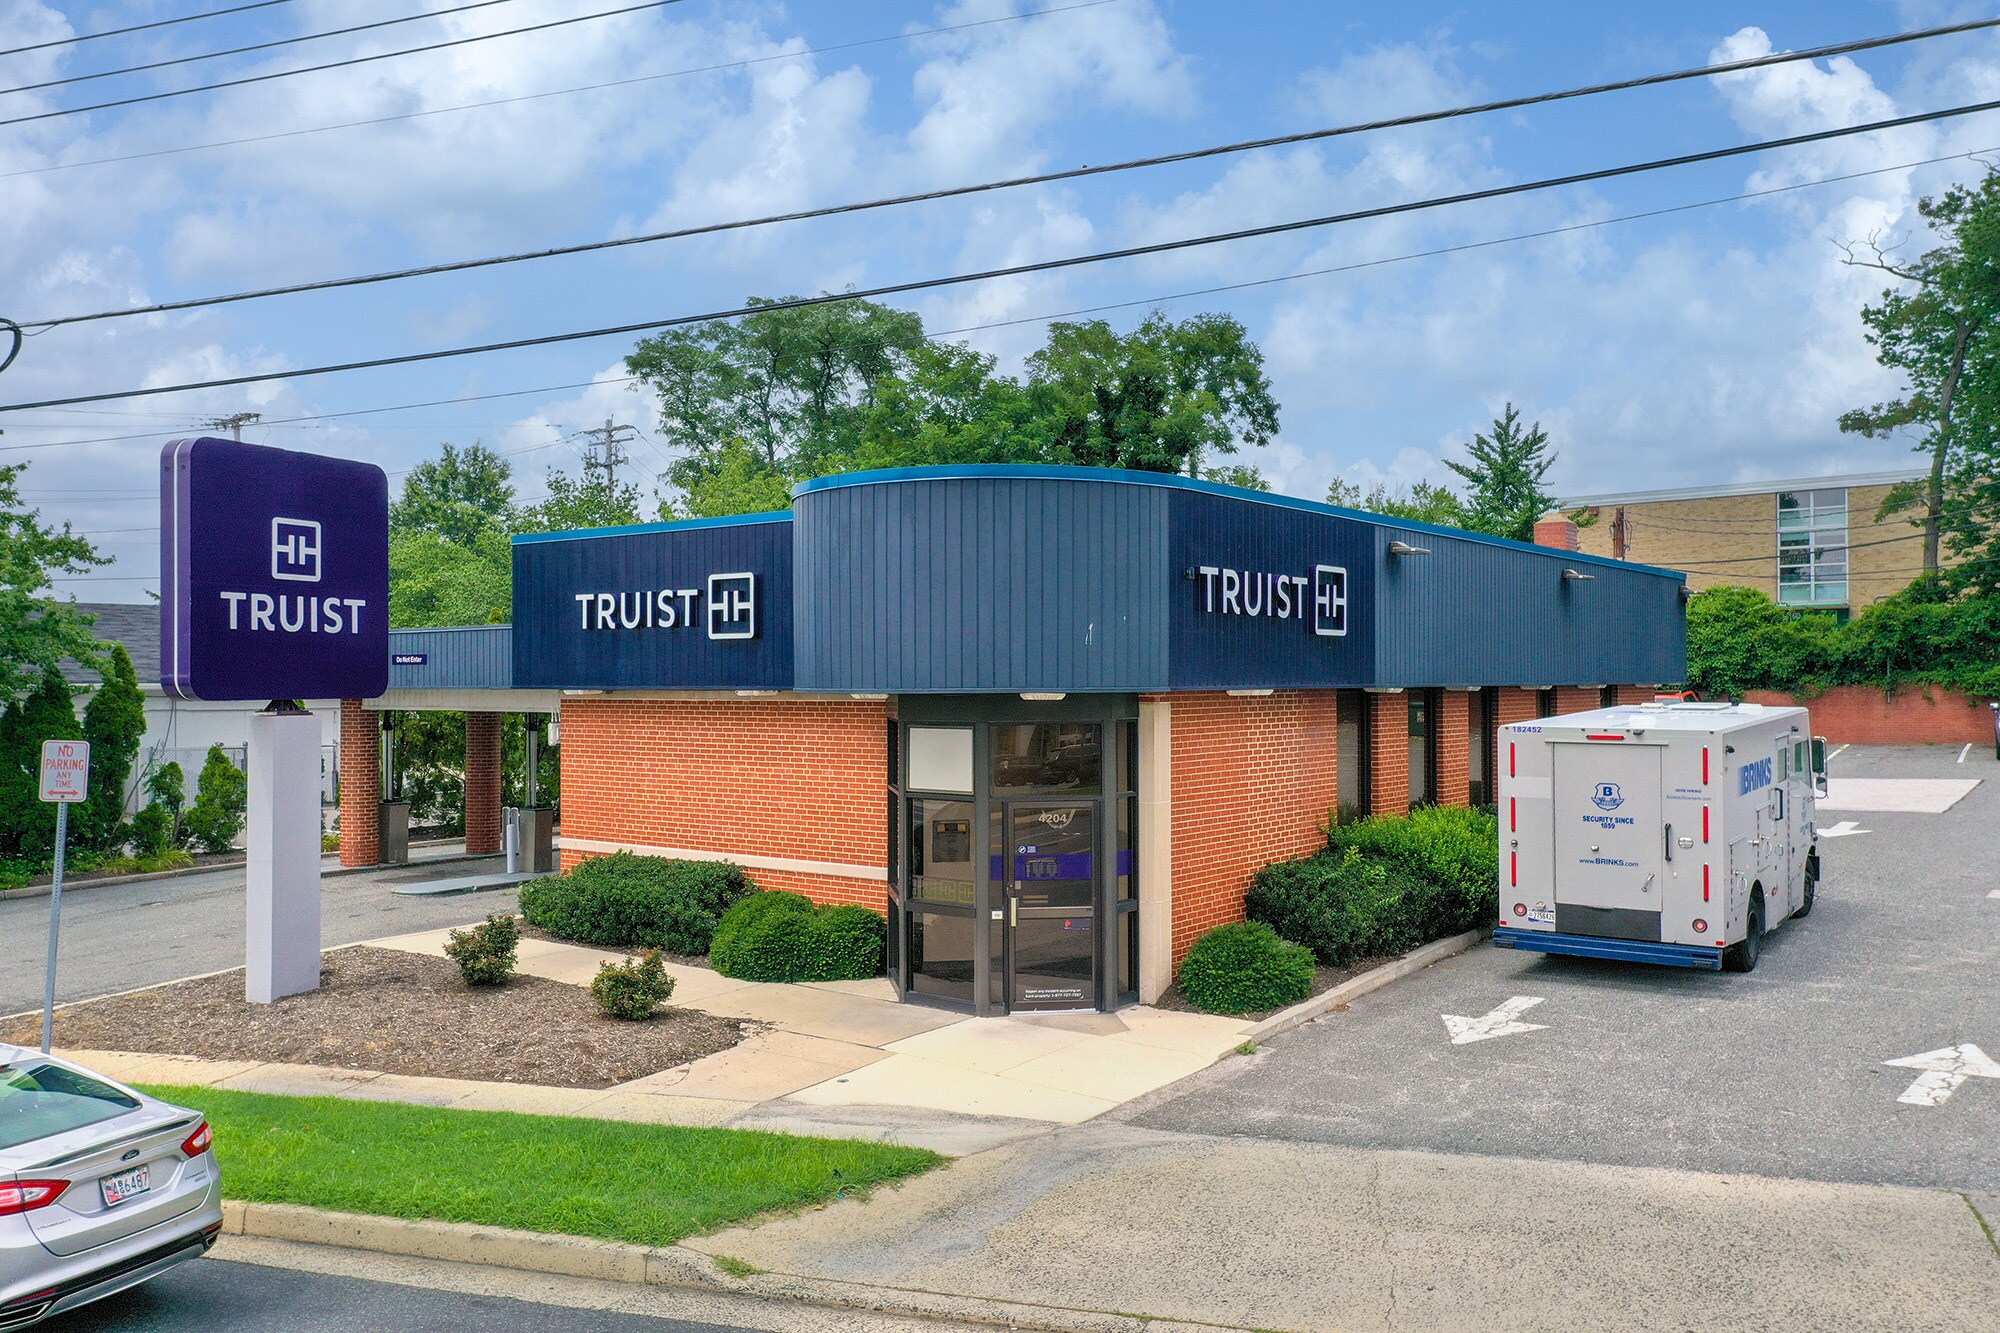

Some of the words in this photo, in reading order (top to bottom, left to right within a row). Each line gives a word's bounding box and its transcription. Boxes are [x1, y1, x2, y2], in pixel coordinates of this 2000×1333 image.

[1200, 566, 1308, 619] TRUIST
[220, 591, 366, 634] TRUIST
[575, 589, 698, 630] TRUIST
[58, 745, 74, 757] NO
[45, 759, 84, 771] PARKING
[57, 771, 72, 779] ANY
[1739, 756, 1772, 796] BRINKS
[56, 780, 72, 788] TIME
[1038, 814, 1067, 823] 4204
[1582, 815, 1613, 823] SECURITY
[1614, 817, 1635, 825] SINCE
[1579, 857, 1639, 867] www.BRINKS.com
